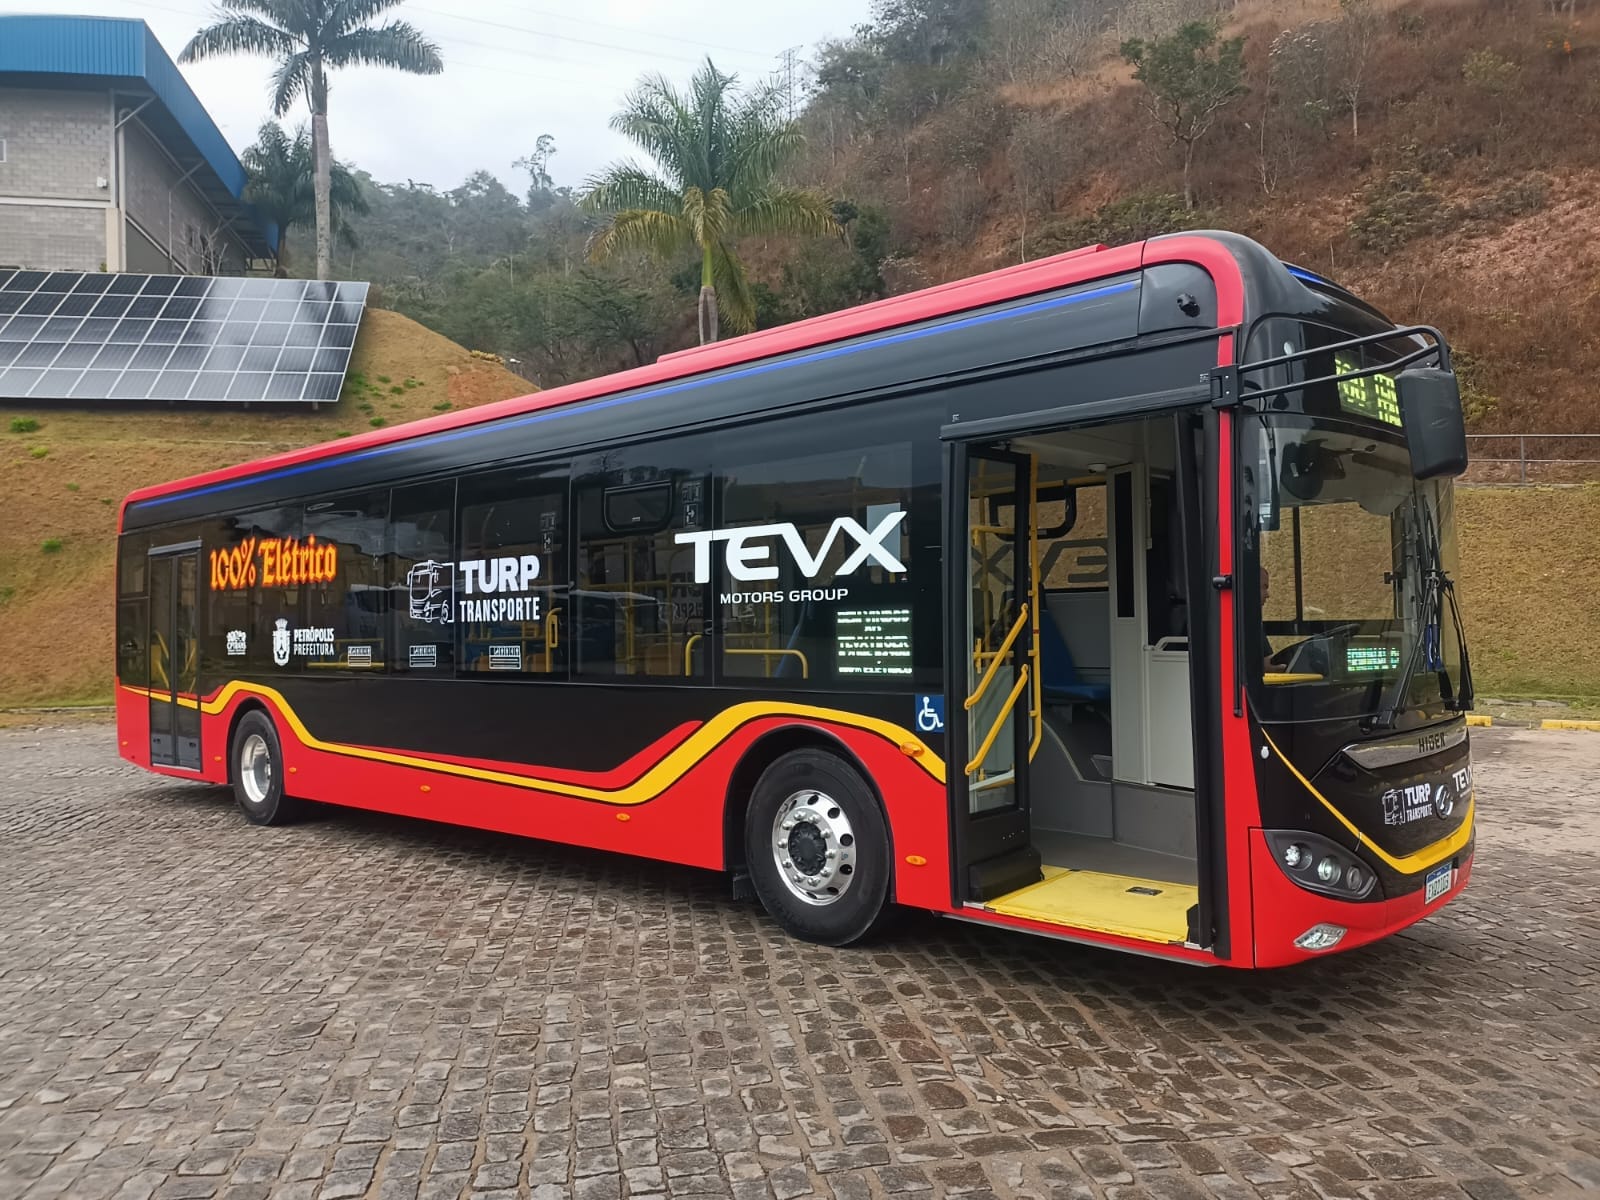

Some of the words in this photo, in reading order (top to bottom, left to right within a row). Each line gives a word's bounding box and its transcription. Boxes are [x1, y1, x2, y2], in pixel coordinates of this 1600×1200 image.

[674, 510, 908, 584] TEVX
[209, 536, 257, 591] 100%
[258, 533, 337, 588] Elétrico
[459, 554, 541, 594] TURP
[720, 591, 784, 605] MOTORS
[789, 588, 849, 602] GROUP
[460, 596, 541, 623] TRANSPORTE
[293, 626, 335, 643] PETRÓPOLIS
[293, 642, 335, 656] PREFEITURA
[1418, 732, 1446, 753] HIGER
[1404, 782, 1431, 807] TURP
[1406, 803, 1433, 822] TRANSPORTE
